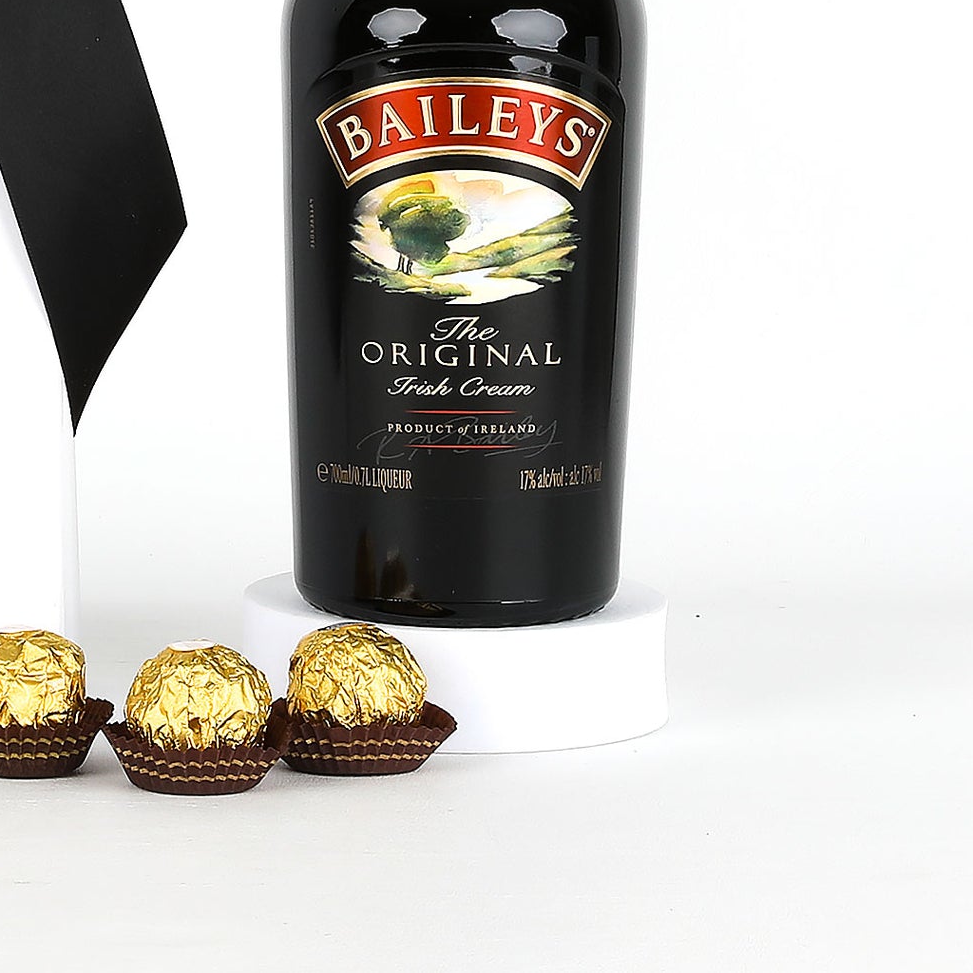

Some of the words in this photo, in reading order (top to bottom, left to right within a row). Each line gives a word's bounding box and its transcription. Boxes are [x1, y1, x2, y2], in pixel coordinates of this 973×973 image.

[430, 316, 499, 342] The
[361, 342, 561, 367] ORIGINAL
[387, 376, 453, 397] Irish
[459, 377, 535, 397] Cream
[387, 423, 453, 434] PRODUCT
[458, 423, 469, 436] of
[474, 423, 537, 434] IRELAND
[372, 468, 413, 493] LIQUEUR
[520, 469, 536, 491] 17%
